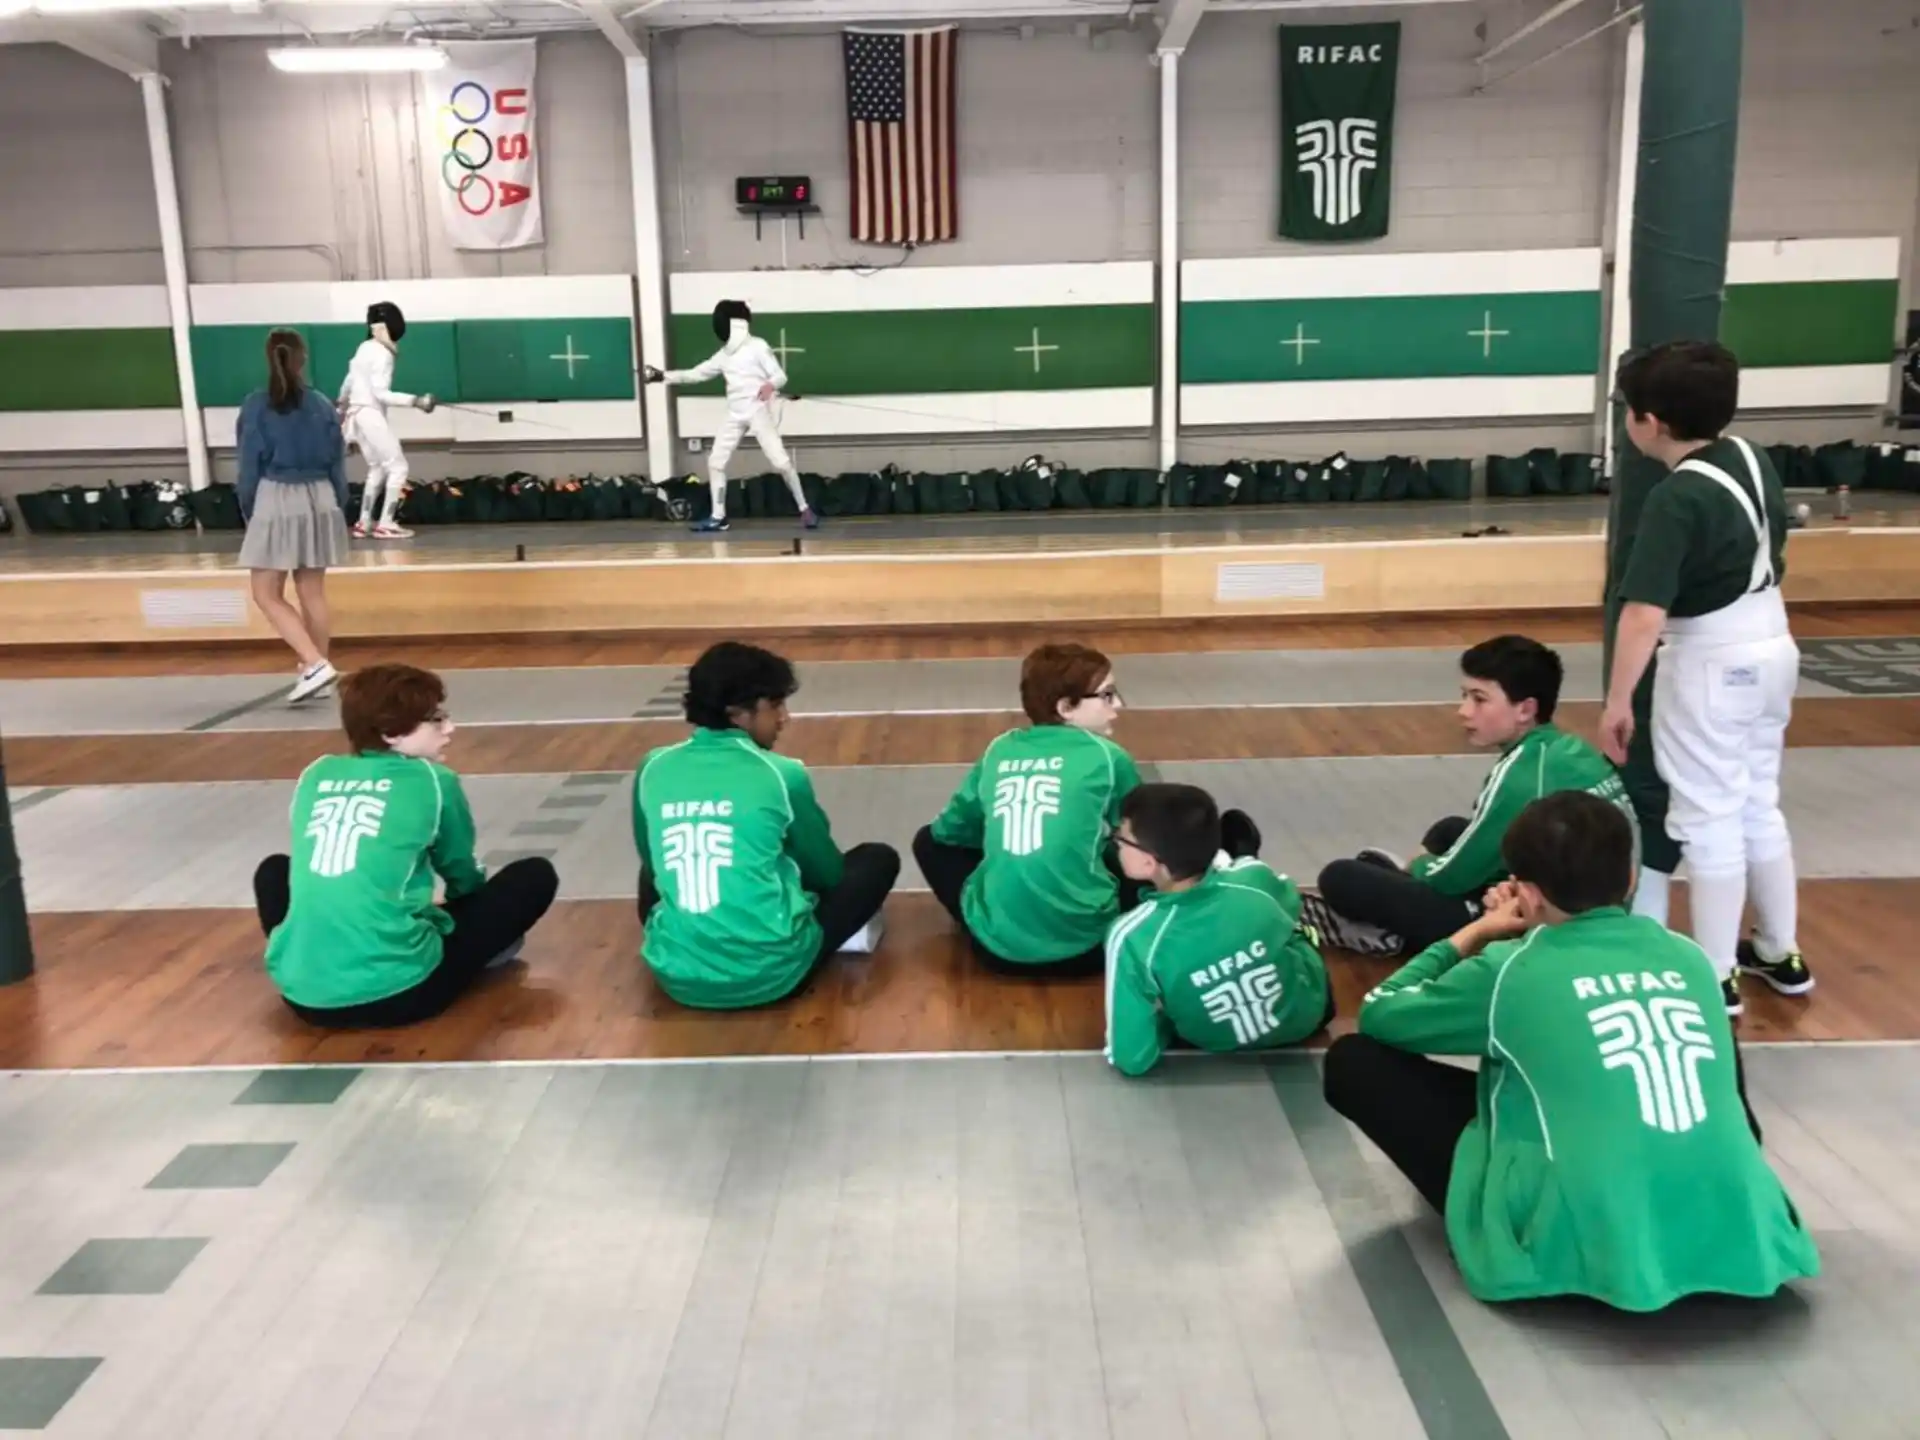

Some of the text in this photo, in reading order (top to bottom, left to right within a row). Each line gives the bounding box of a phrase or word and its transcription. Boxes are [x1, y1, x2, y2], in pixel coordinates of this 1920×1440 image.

[1297, 44, 1381, 64] RIFAC
[495, 88, 530, 208] USA
[998, 756, 1064, 773] RIFAC
[317, 778, 393, 793] RIFAC
[661, 799, 733, 819] RIFAC
[1189, 940, 1267, 987] RIFAC
[1572, 970, 1687, 1000] RIFAC
